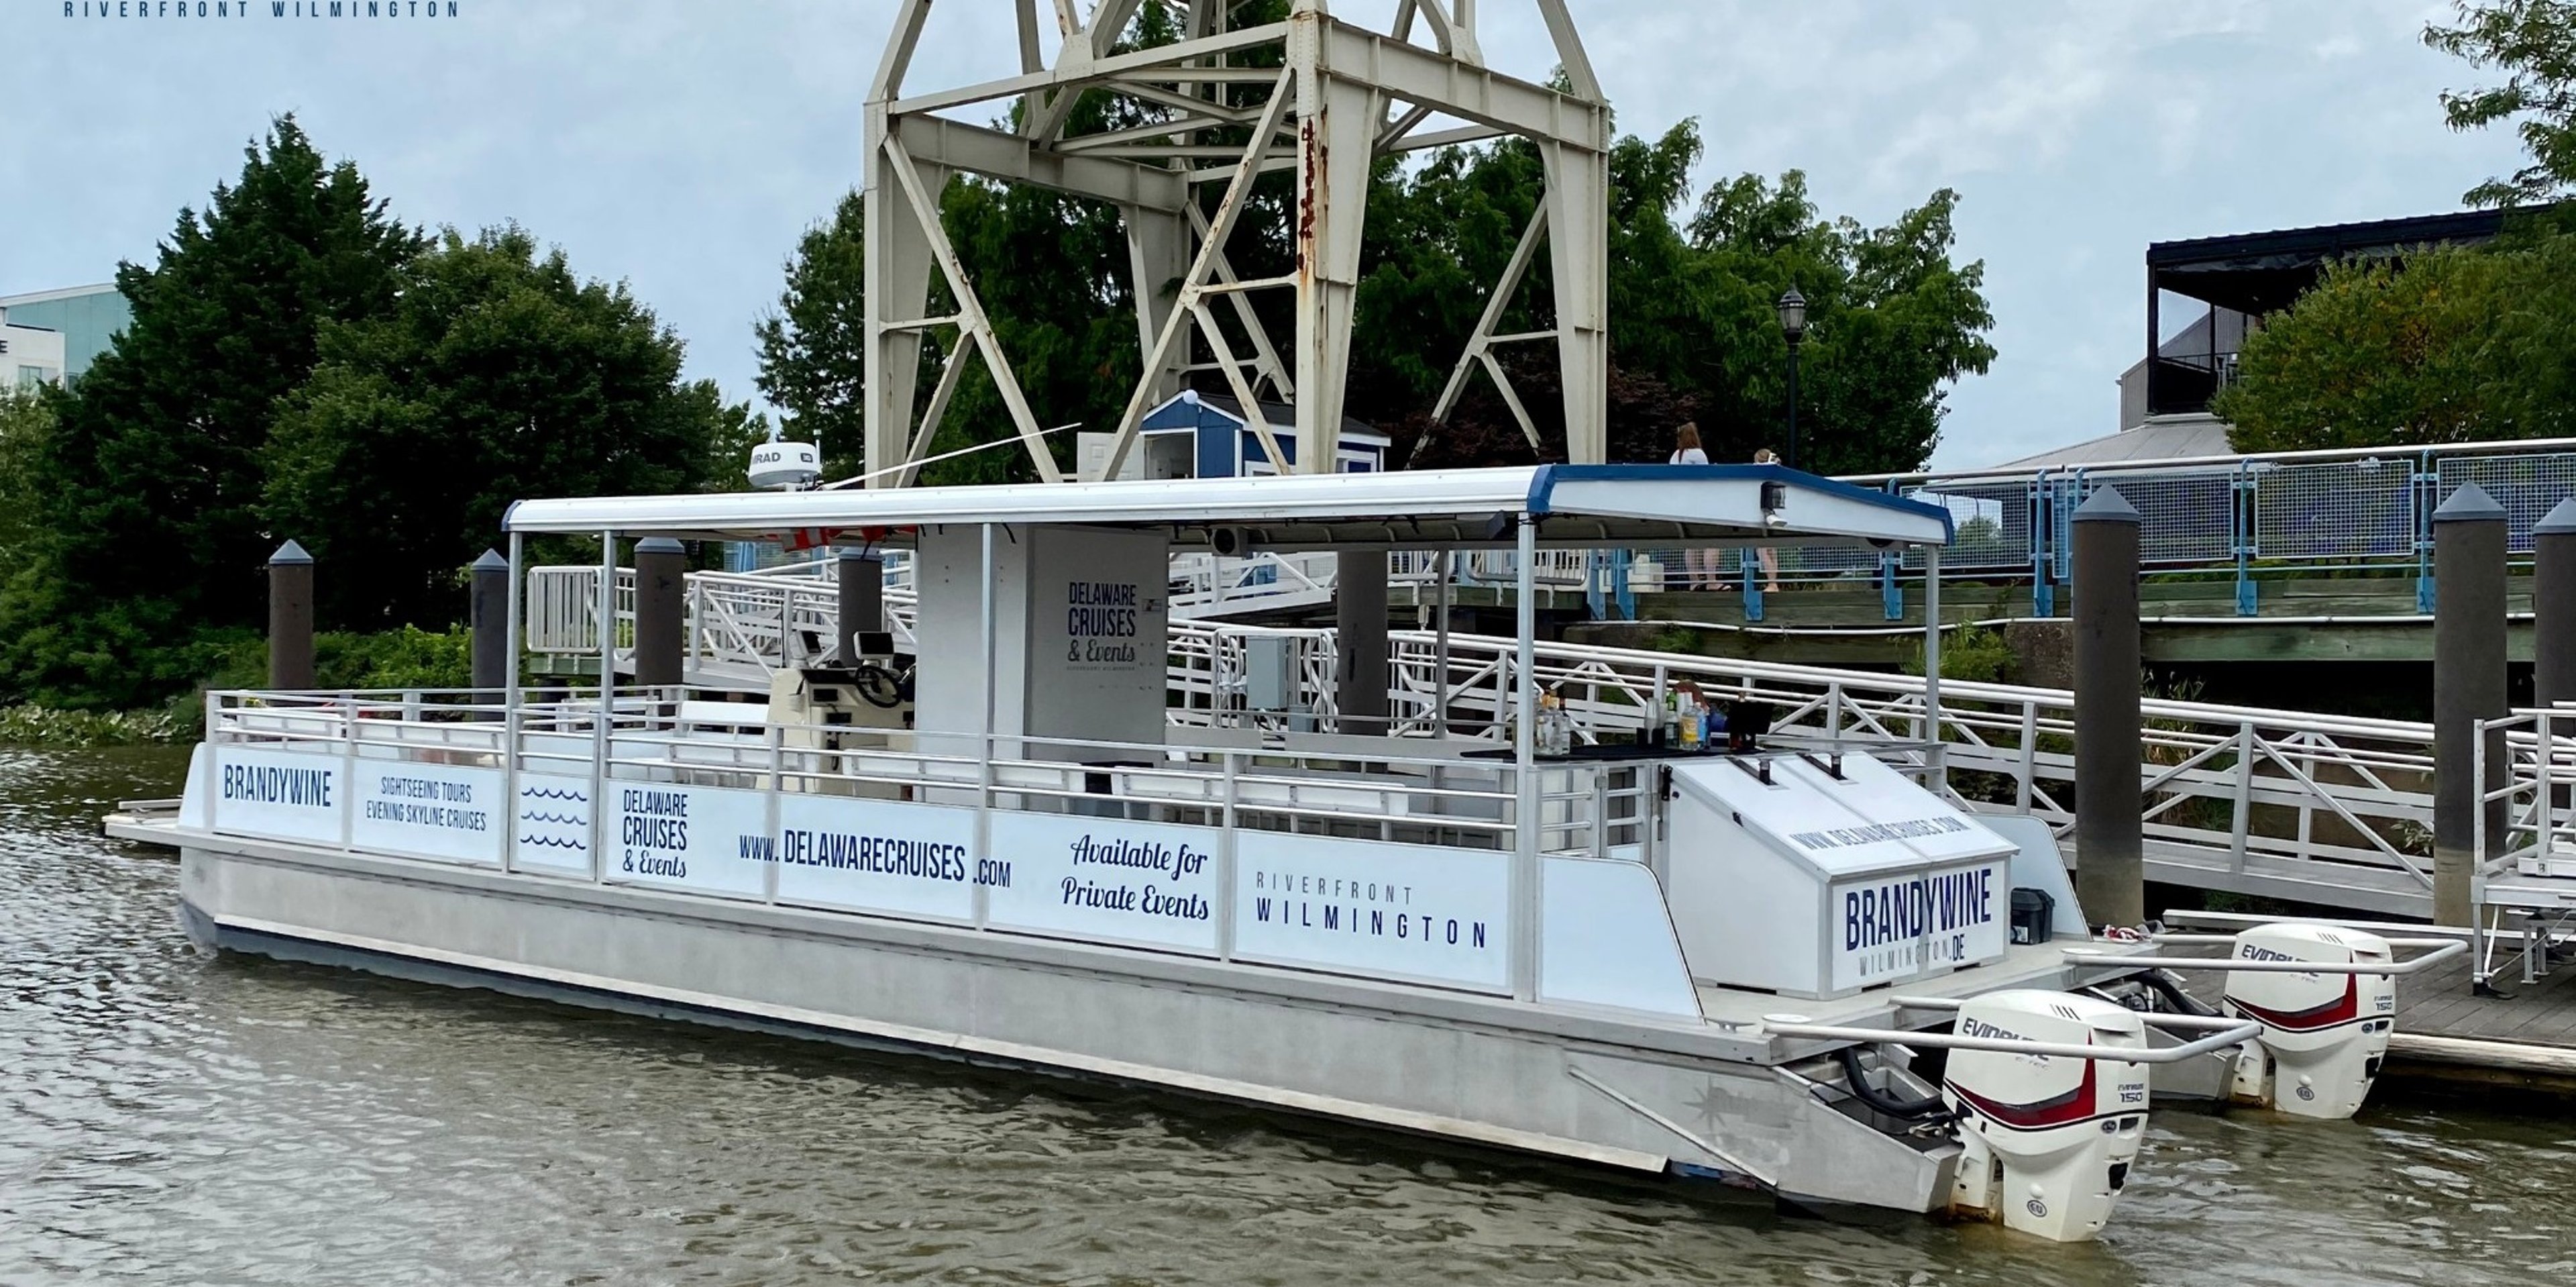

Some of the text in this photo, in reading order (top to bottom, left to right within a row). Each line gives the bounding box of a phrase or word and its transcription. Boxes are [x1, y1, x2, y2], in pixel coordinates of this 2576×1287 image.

[1069, 582, 1136, 606] DELAWARE
[1068, 607, 1136, 637] CRUISES
[1067, 639, 1136, 662] & Events
[224, 764, 331, 807] BRANDYWINE
[380, 776, 472, 803] SIGHTSEEING TOURS
[366, 800, 487, 832] EVENING SKYLINE CRUISES
[623, 789, 688, 817] DELAWARE
[623, 815, 688, 851] CRUISES
[623, 849, 687, 878] & Events
[784, 829, 966, 882] DELAWARECRUISES
[1071, 834, 1208, 881] Available for
[1061, 876, 1209, 921] Private Events
[1256, 871, 1412, 905] RIVERFRONT
[1256, 898, 1485, 948] WILMINGTON
[1846, 868, 1992, 951] BRANDYWINE
[2120, 1092, 2143, 1103] 150
